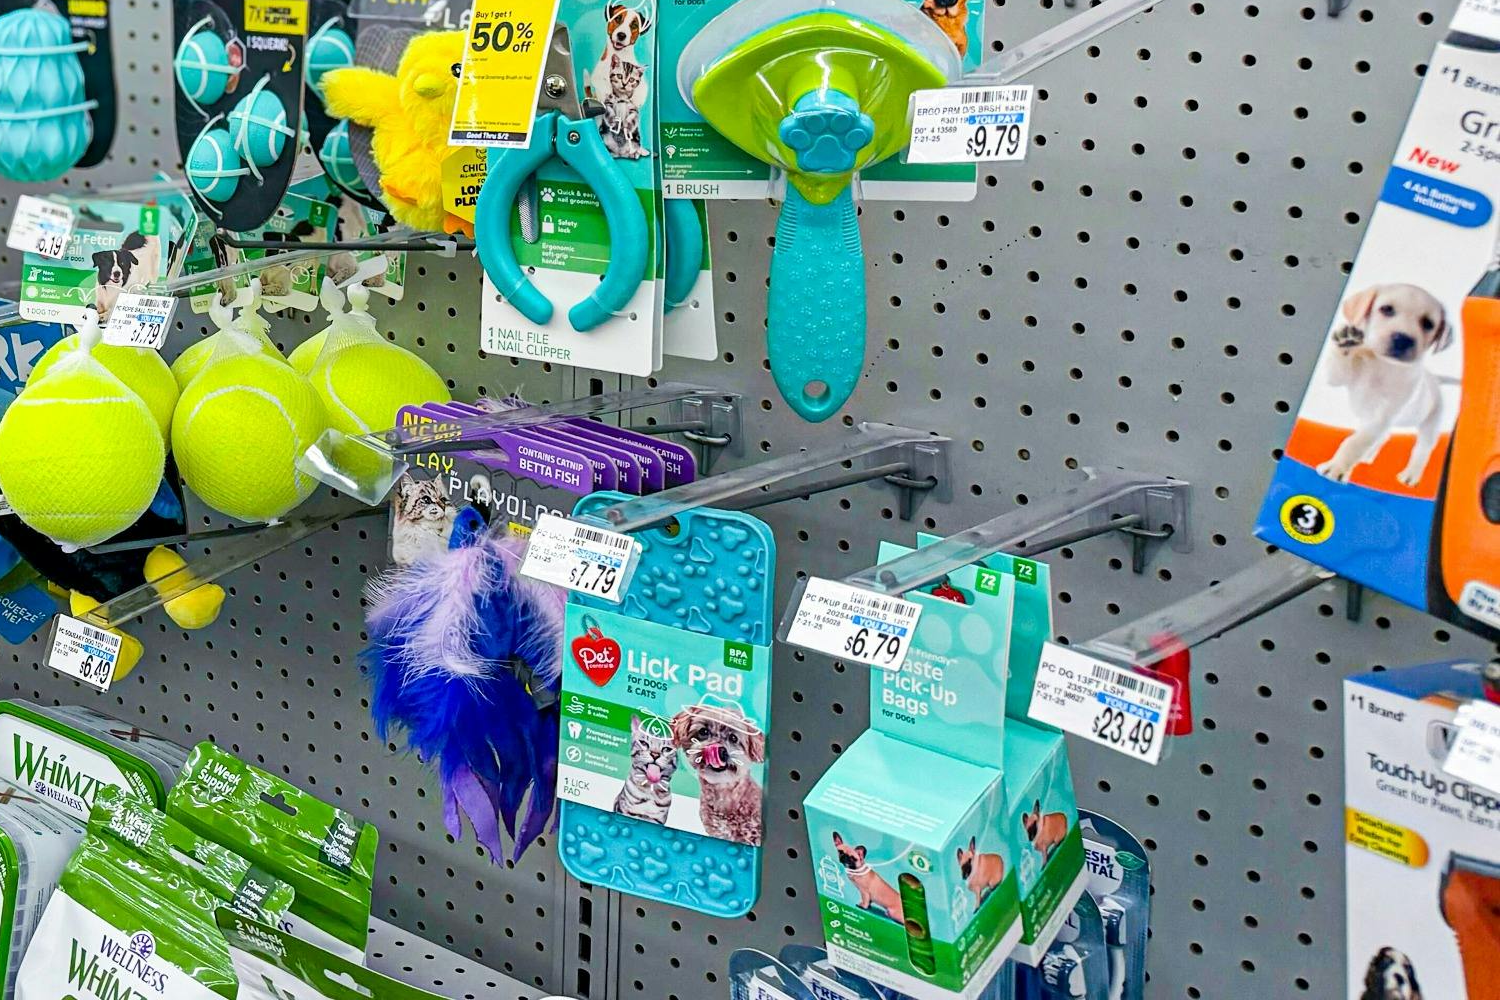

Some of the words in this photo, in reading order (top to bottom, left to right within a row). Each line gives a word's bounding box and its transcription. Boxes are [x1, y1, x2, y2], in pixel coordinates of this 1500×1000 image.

[471, 22, 534, 52] 50%
[917, 107, 940, 116] ERGO
[966, 125, 1020, 157] $9.79
[1408, 147, 1460, 174] New
[665, 185, 671, 194] 1
[676, 184, 719, 194] BRUSH
[570, 198, 599, 207] grooming
[558, 219, 577, 228] Safety
[83, 234, 116, 246] Fetch
[542, 243, 575, 252] Ergonomic
[488, 328, 494, 338] 1
[498, 328, 523, 342] NAIL
[526, 331, 549, 345] FILE
[488, 339, 494, 349] 1
[498, 339, 523, 353] NAIL
[526, 343, 571, 360] CLIPPER
[518, 446, 550, 463] CONTAINS
[552, 458, 584, 471] CATNIP
[519, 459, 553, 477] BETTA
[555, 470, 580, 486] FISH
[1297, 504, 1319, 529] 3
[569, 561, 616, 594] $7.79
[981, 573, 997, 587] 72
[1017, 563, 1033, 576] 72
[805, 593, 816, 602] PC
[818, 597, 840, 608] PKUP
[842, 602, 865, 615] BAGS
[1, 610, 22, 625] ME!
[859, 617, 879, 630] YOU
[880, 623, 901, 635] PAY
[729, 648, 748, 659] BPA
[844, 628, 900, 664] $6.79
[80, 655, 110, 684] $6.49
[579, 648, 614, 670] Pet
[729, 657, 747, 665] FREE
[627, 650, 678, 682] Lick
[688, 664, 742, 696] Pad
[628, 674, 642, 684] for
[643, 678, 668, 691] DOGS
[1042, 661, 1057, 673] PC
[1058, 668, 1074, 679] DG
[1077, 674, 1100, 688] 13FT
[627, 685, 633, 693] &
[635, 687, 656, 699] CATS
[883, 669, 957, 705] Pick-Up
[883, 689, 928, 716] Bags
[882, 709, 893, 717] for
[895, 712, 915, 724] DOGS
[1092, 708, 1154, 754] $23.49
[198, 768, 236, 796] Supply!
[205, 758, 212, 770] 1
[214, 762, 242, 786] Week
[1367, 752, 1447, 796] Touch-Up
[564, 786, 580, 796] PAD
[572, 779, 590, 790] LICK
[46, 786, 83, 812] WELLNESS
[125, 811, 153, 833] Week
[334, 830, 354, 845] Longer
[242, 887, 262, 903] Longer
[236, 919, 244, 930] 2
[245, 923, 284, 945] Week
[100, 935, 169, 994] WELLNESS
